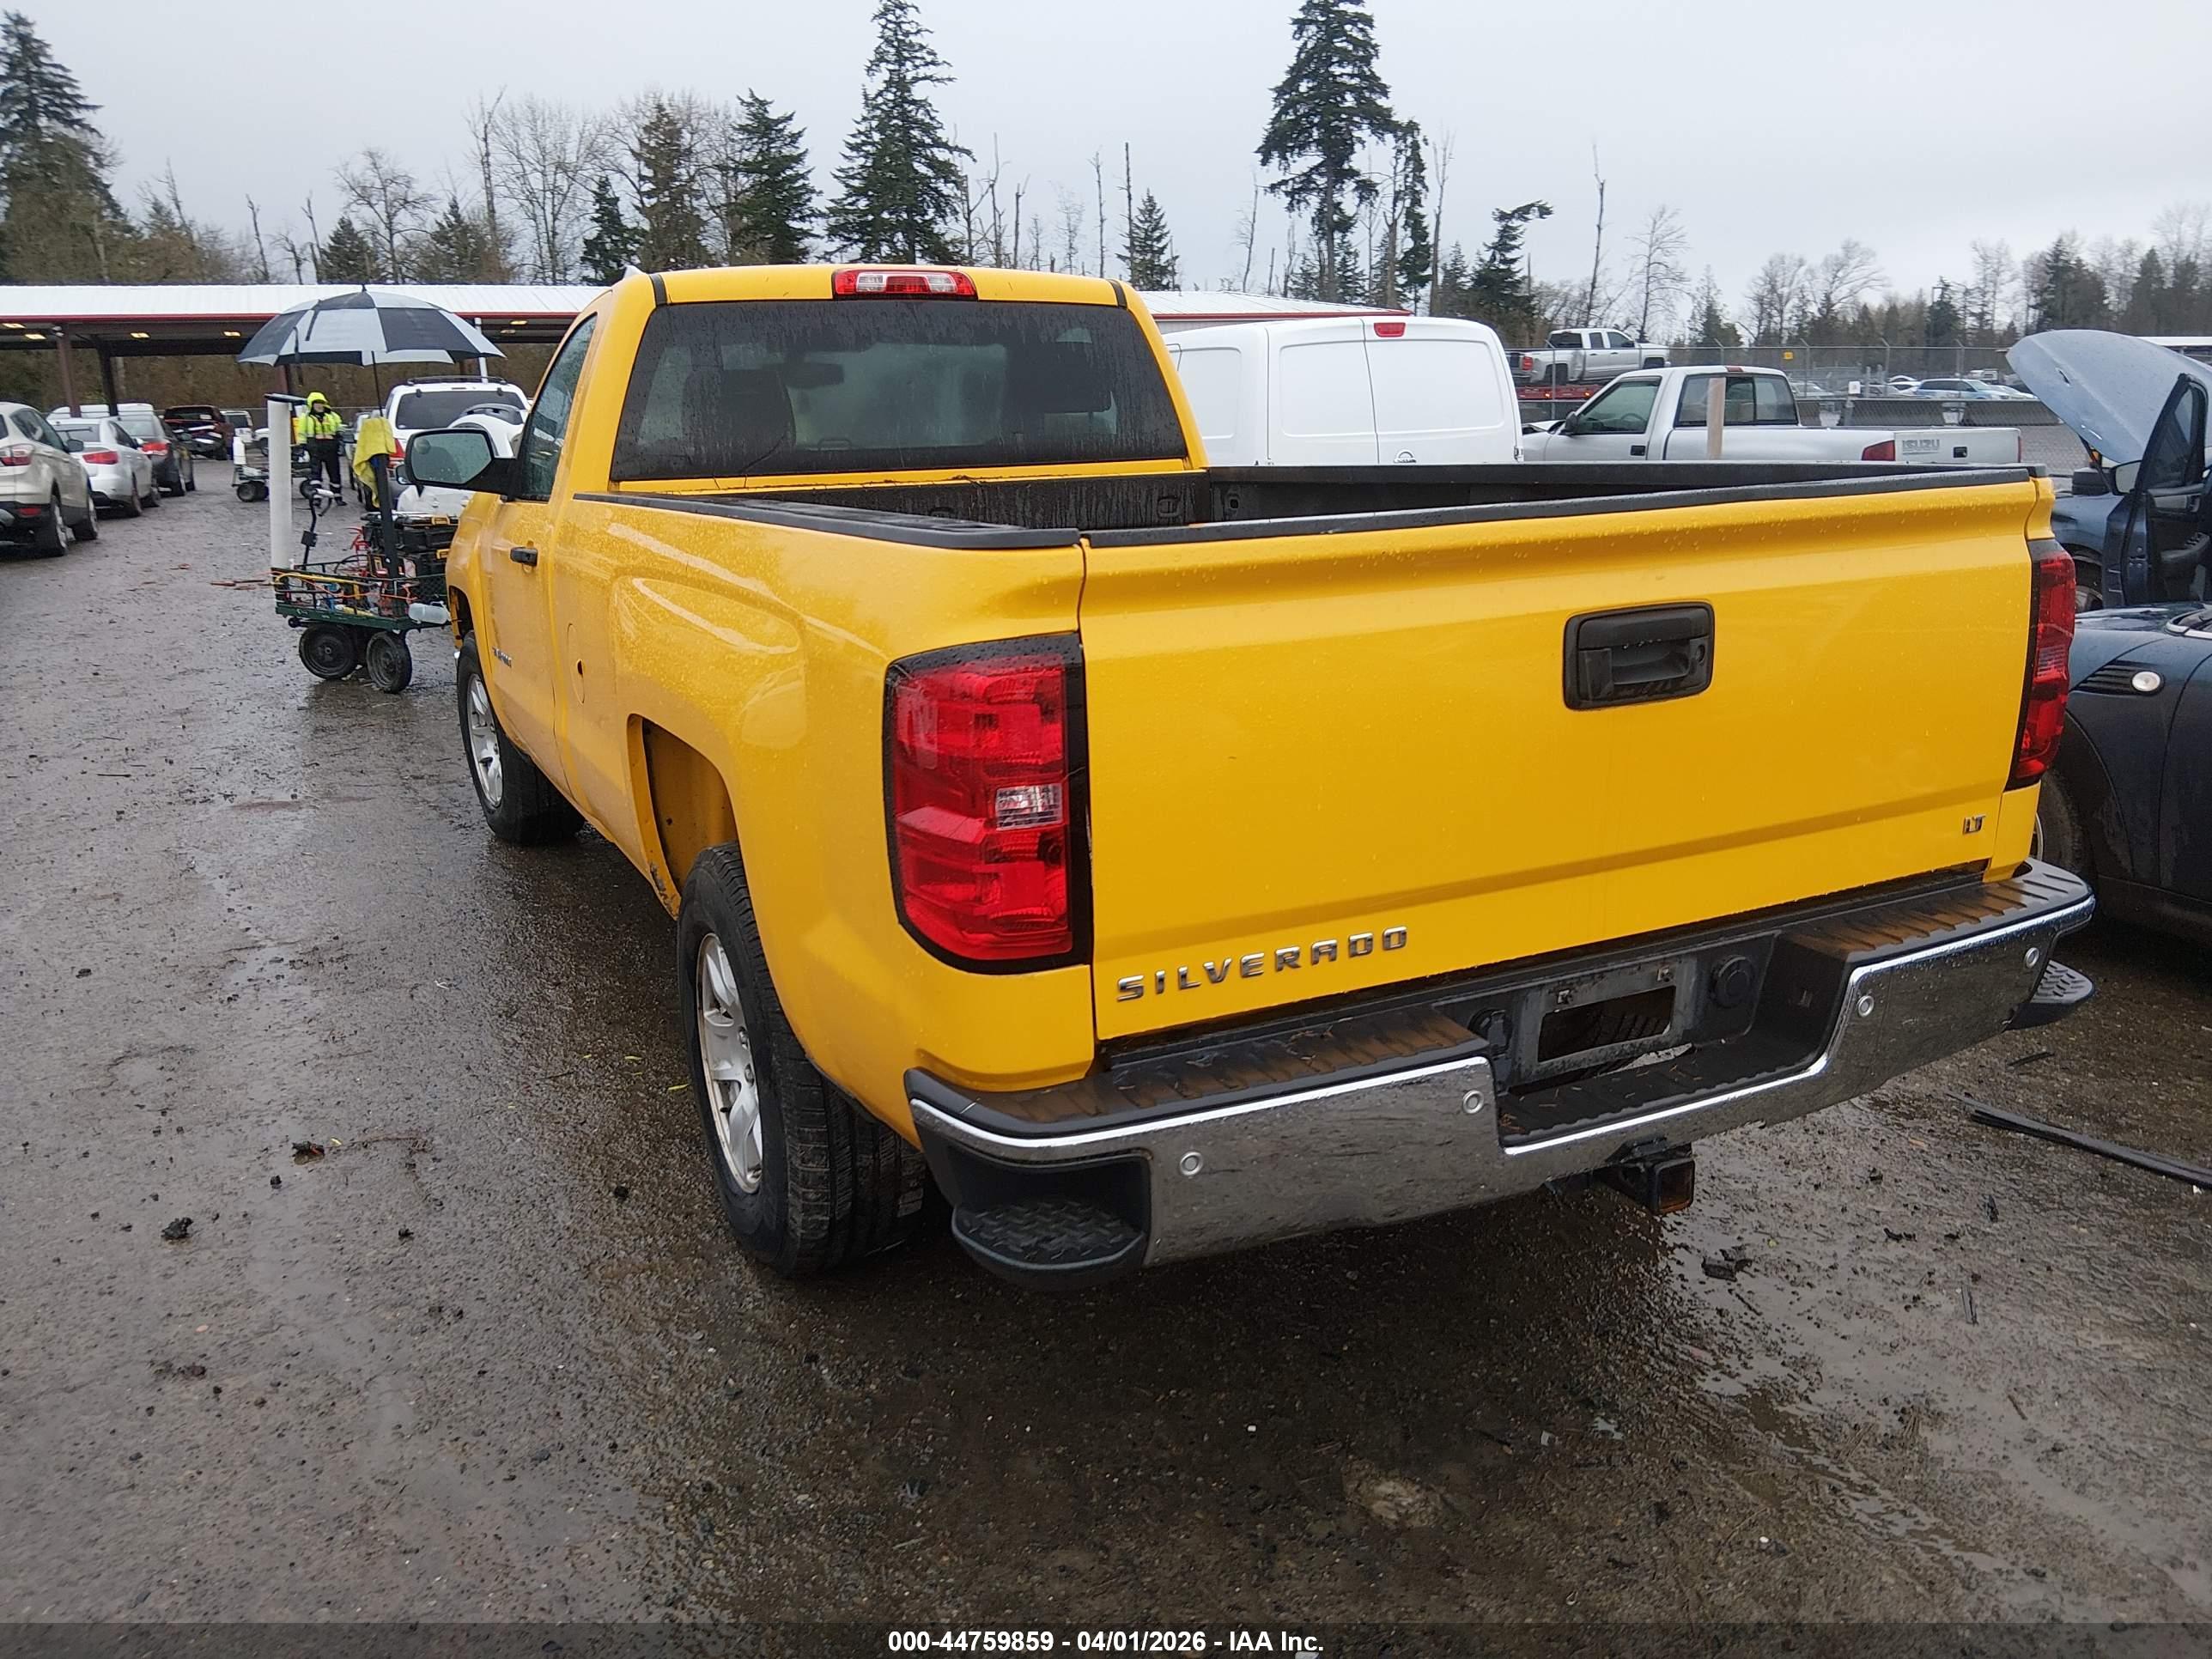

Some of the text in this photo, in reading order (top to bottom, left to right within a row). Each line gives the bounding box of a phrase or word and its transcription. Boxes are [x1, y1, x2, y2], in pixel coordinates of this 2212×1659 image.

[1902, 439, 1941, 449] ISUZU
[1962, 814, 1986, 836] LT
[1116, 926, 1407, 1002] SILVERADO
